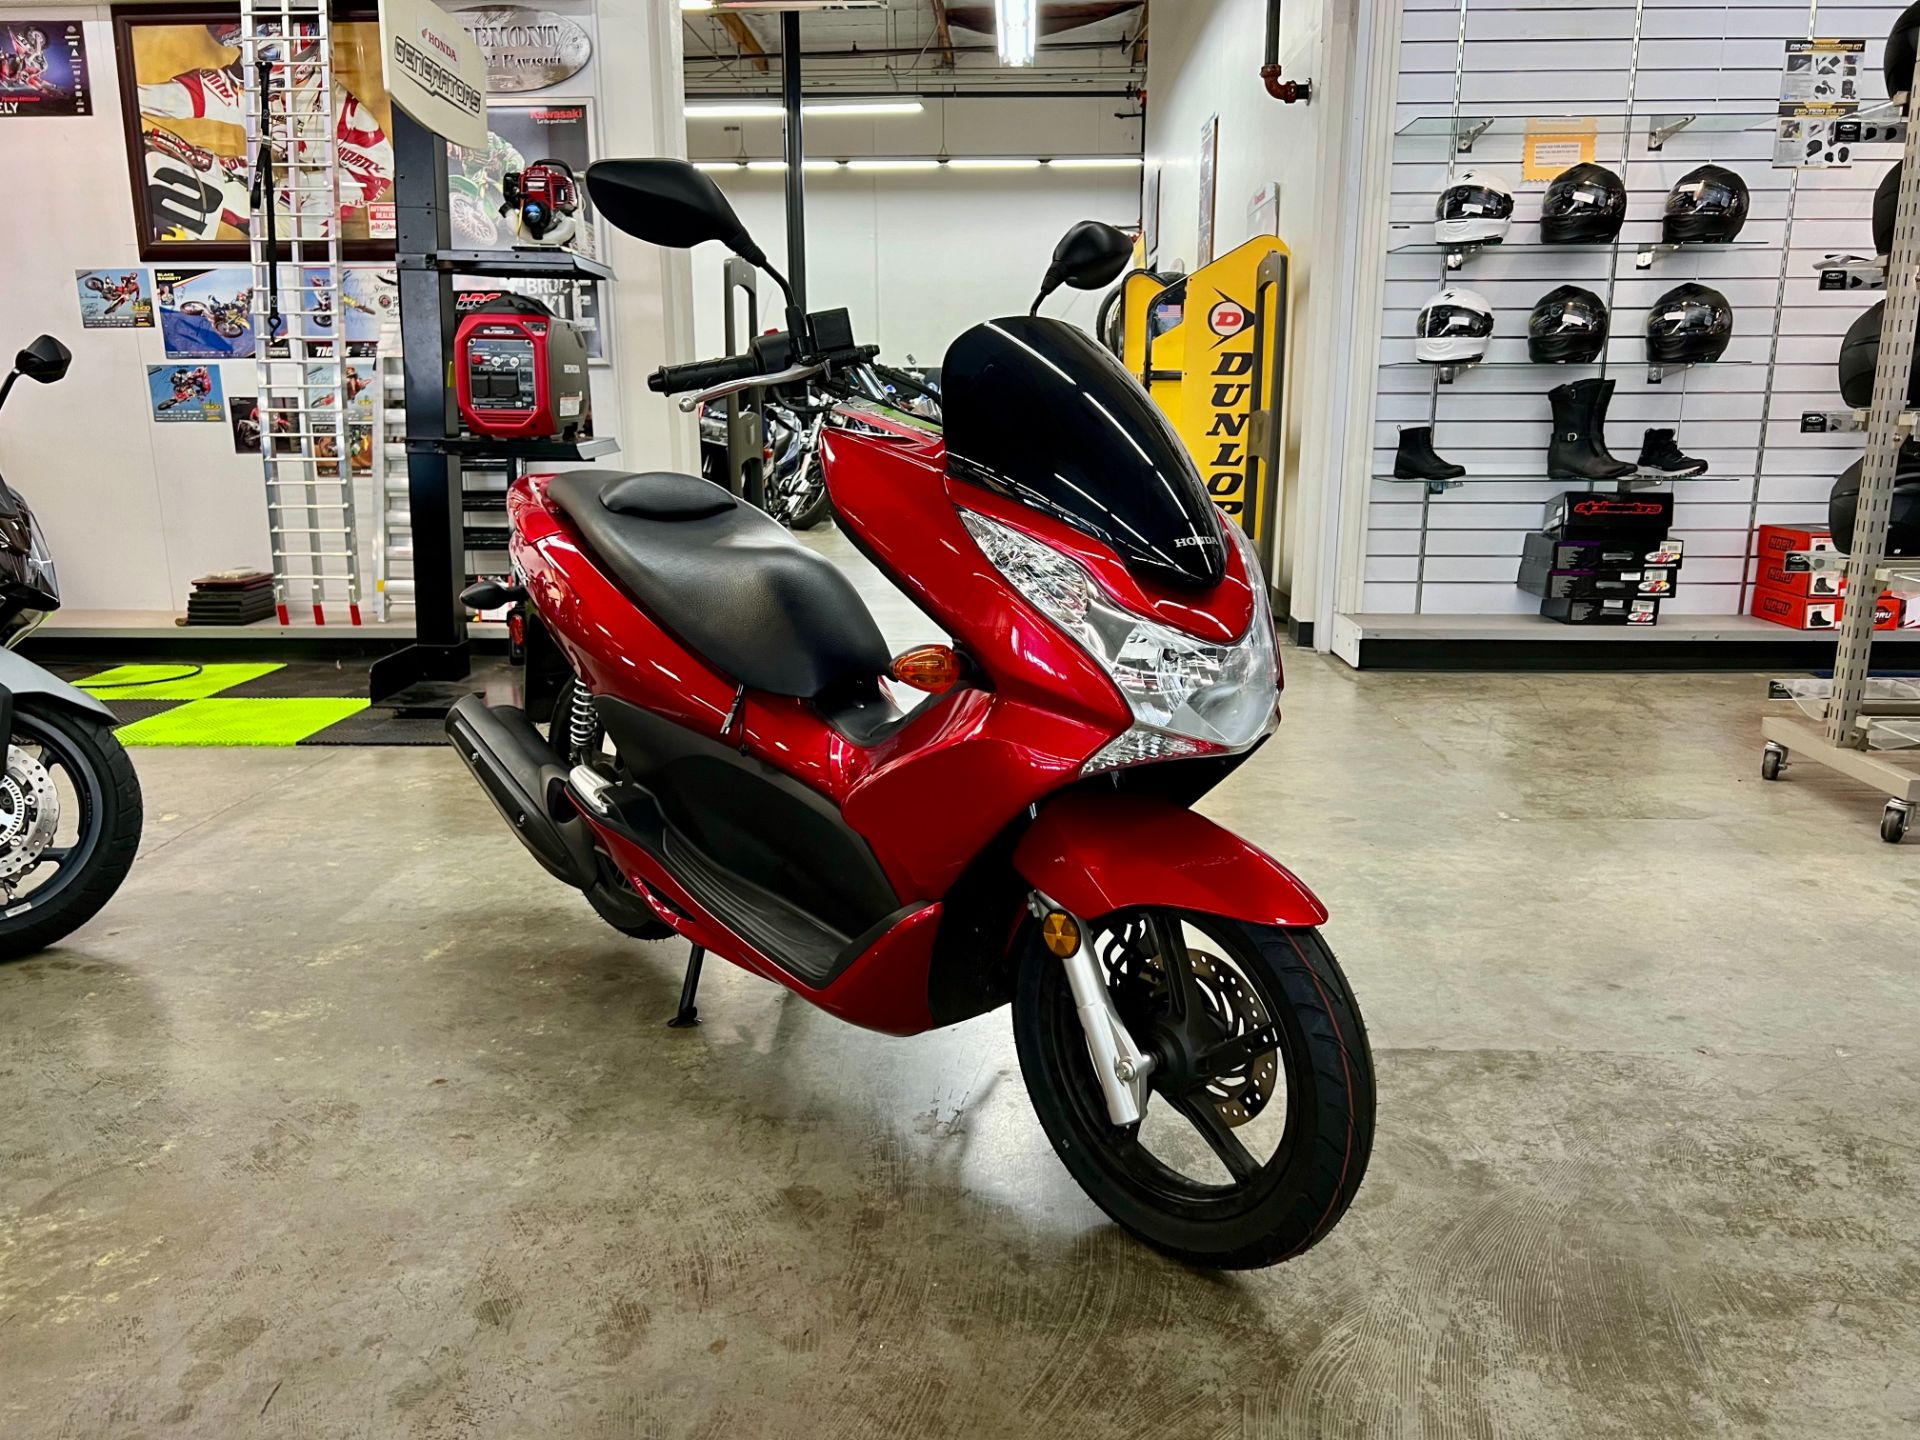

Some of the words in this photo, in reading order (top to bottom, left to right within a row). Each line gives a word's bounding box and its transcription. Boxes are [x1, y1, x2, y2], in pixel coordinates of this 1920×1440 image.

[472, 26, 558, 48] EMONT
[428, 31, 457, 62] HONDA
[394, 35, 481, 114] GENERATORS
[529, 109, 583, 119] Kawasaki
[1215, 312, 1242, 326] D
[1205, 352, 1253, 515] DUNLOP
[1174, 536, 1219, 548] HONDA
[1770, 537, 1794, 550] NORU
[1765, 598, 1789, 614] NORU
